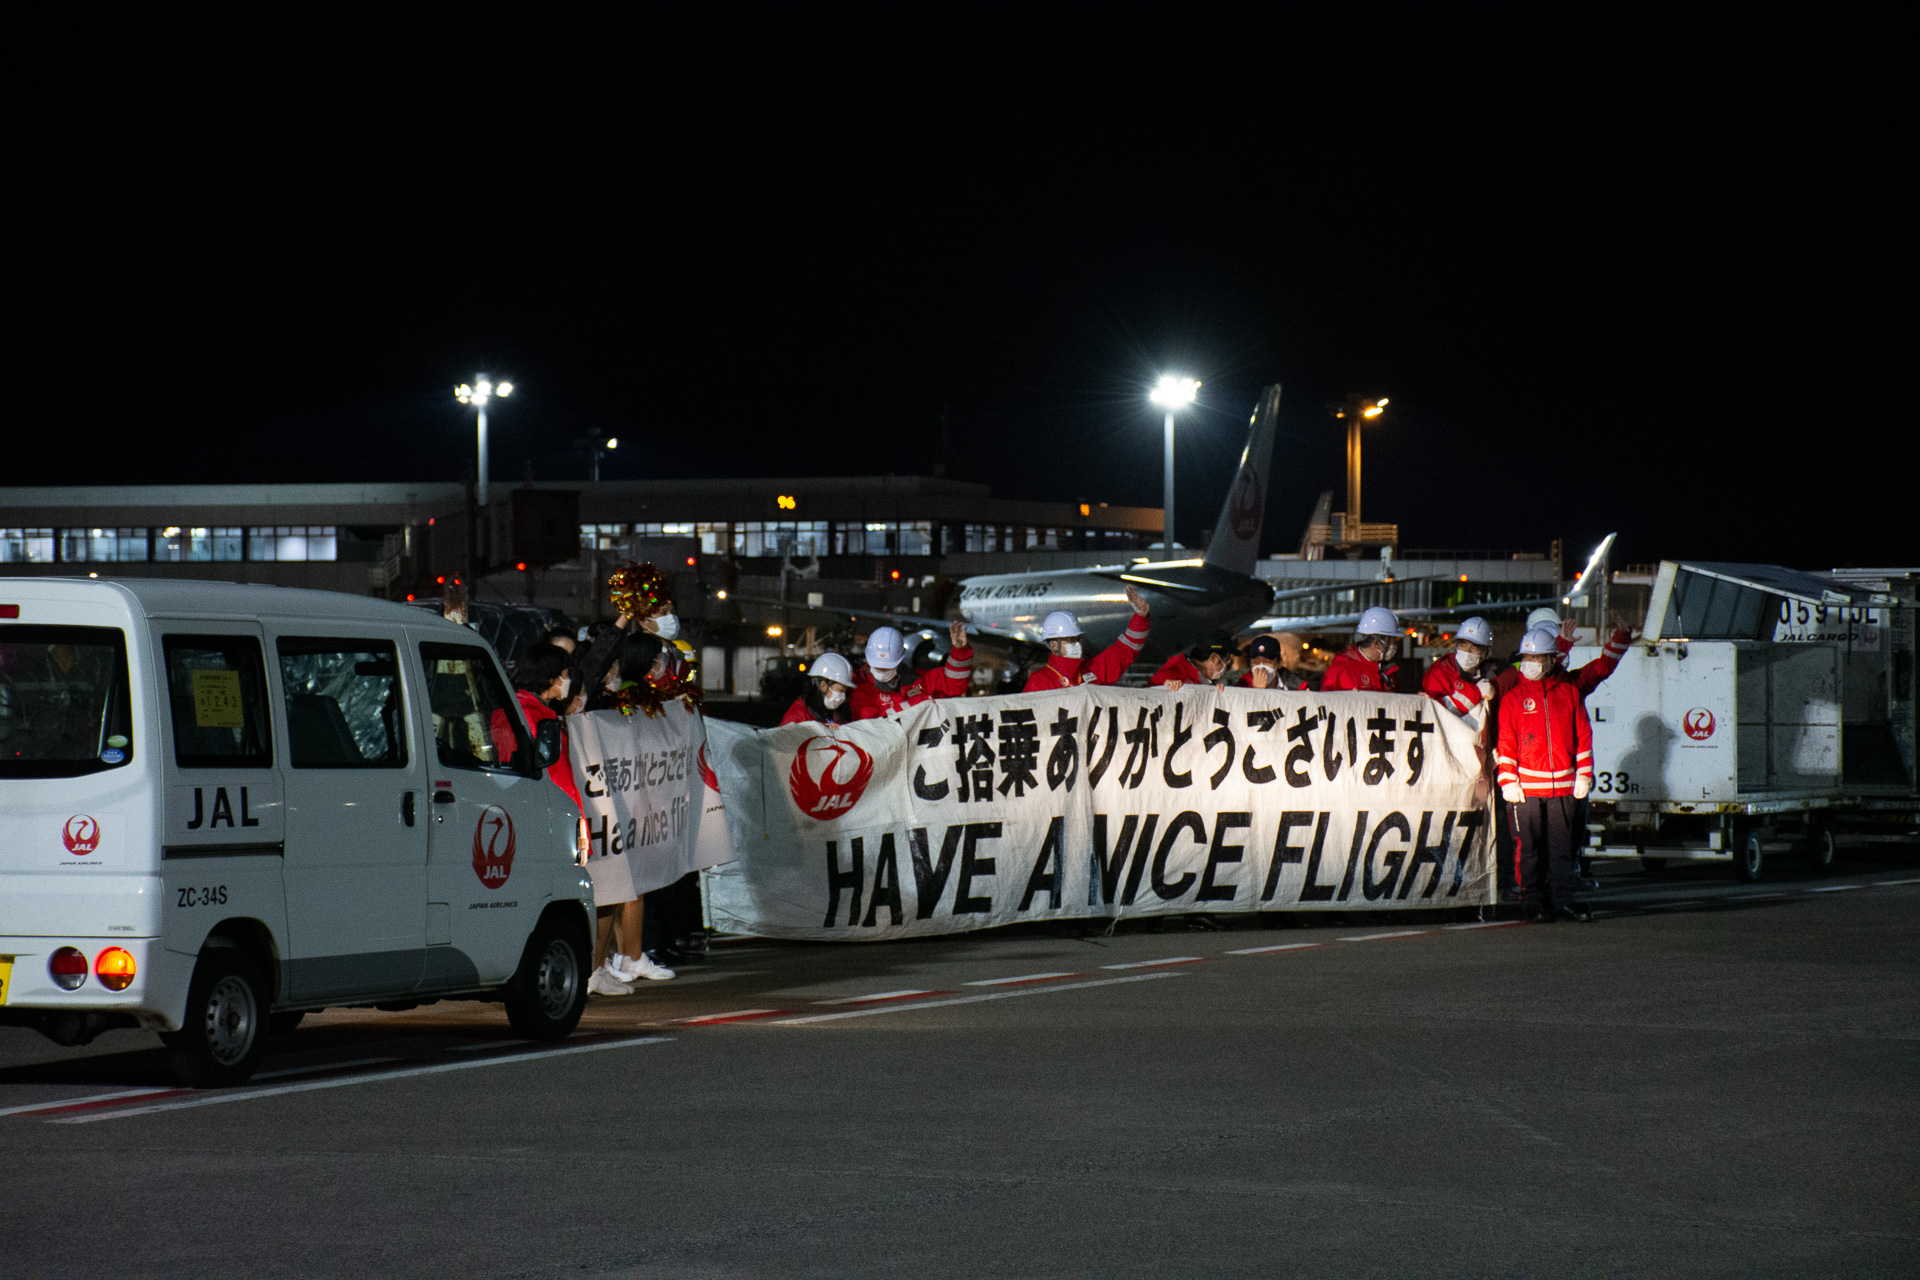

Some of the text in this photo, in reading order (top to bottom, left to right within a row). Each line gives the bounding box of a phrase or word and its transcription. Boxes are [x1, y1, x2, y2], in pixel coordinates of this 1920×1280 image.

[913, 702, 1434, 802] ご搭乗ありがとうございます
[187, 786, 259, 830] JAL
[811, 794, 854, 812] JAL
[71, 843, 93, 851] JAL
[483, 865, 507, 879] JAL
[824, 811, 1485, 927] HAVE A NICE FLIGHT
[177, 885, 228, 908] ZC-34S
[468, 901, 518, 910] JAPAN AIRLINES
